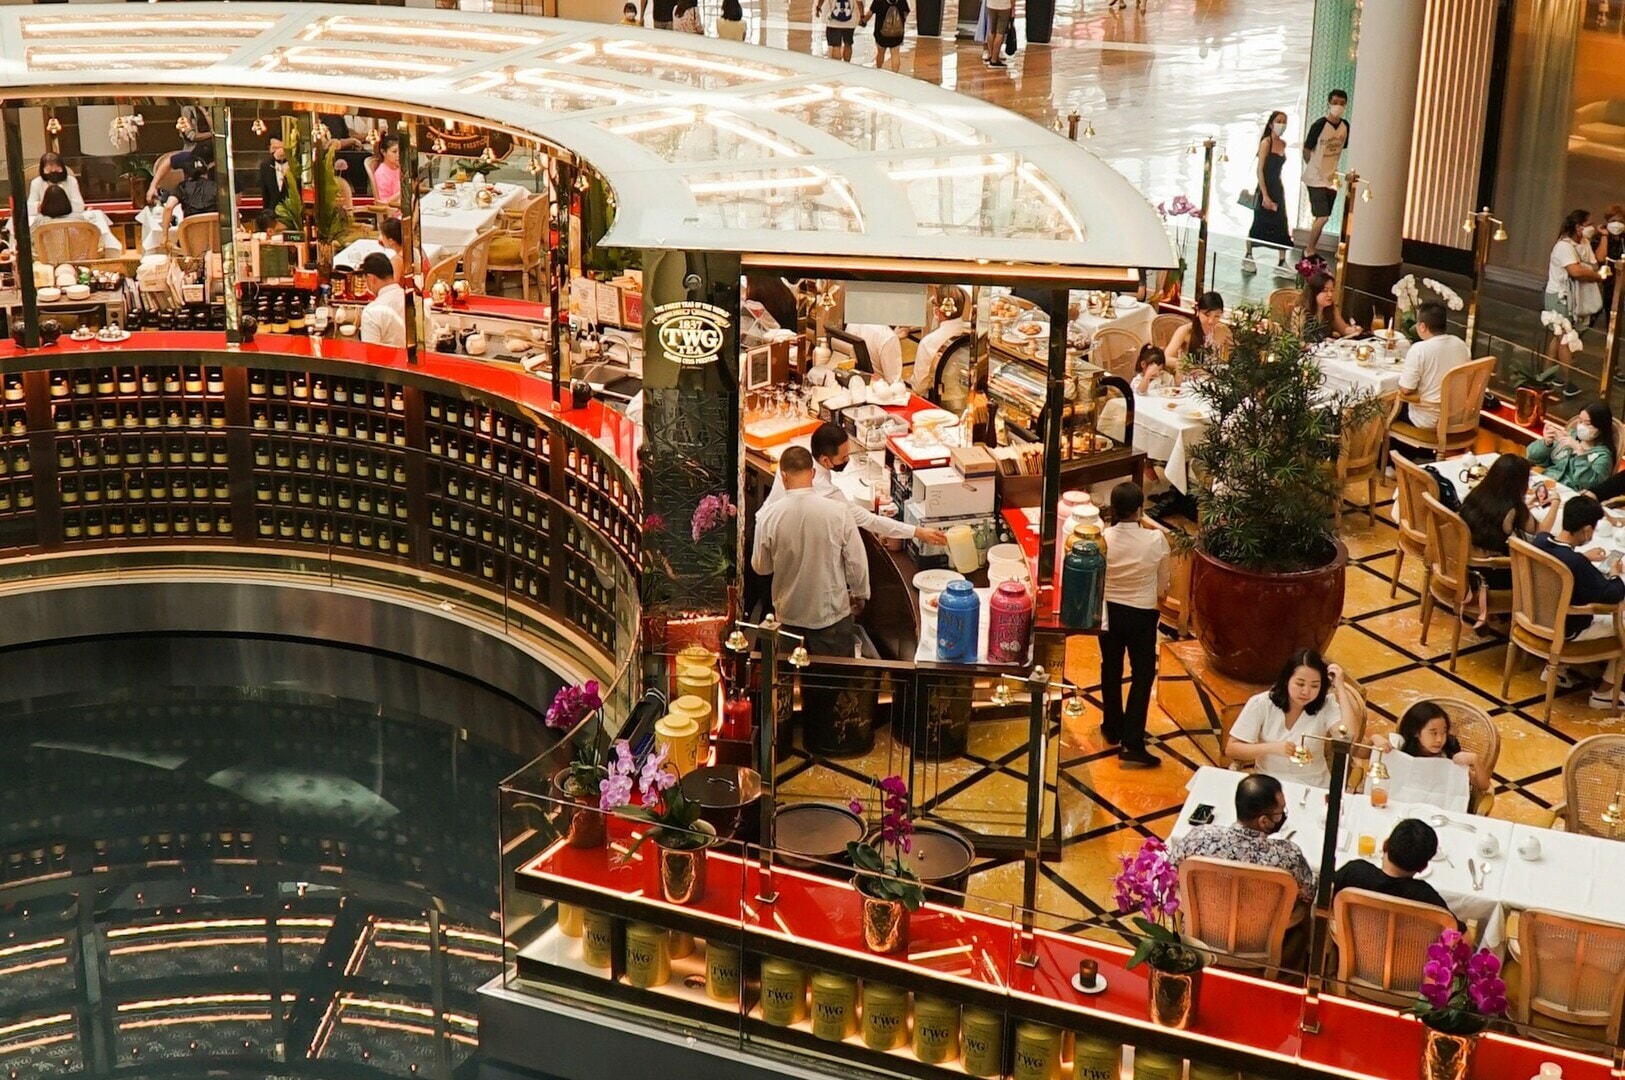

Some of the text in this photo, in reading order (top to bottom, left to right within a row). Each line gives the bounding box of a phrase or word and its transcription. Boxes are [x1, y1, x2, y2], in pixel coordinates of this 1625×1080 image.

[678, 319, 703, 330] 1837
[663, 328, 719, 349] TWG
[676, 345, 704, 355] TEA
[766, 988, 793, 1001] TWG
[817, 1002, 844, 1015] TWG
[871, 1013, 900, 1025] TWG
[921, 1026, 949, 1038] TWG
[1016, 1052, 1043, 1067] TWG
[1082, 1067, 1111, 1080] TWG
